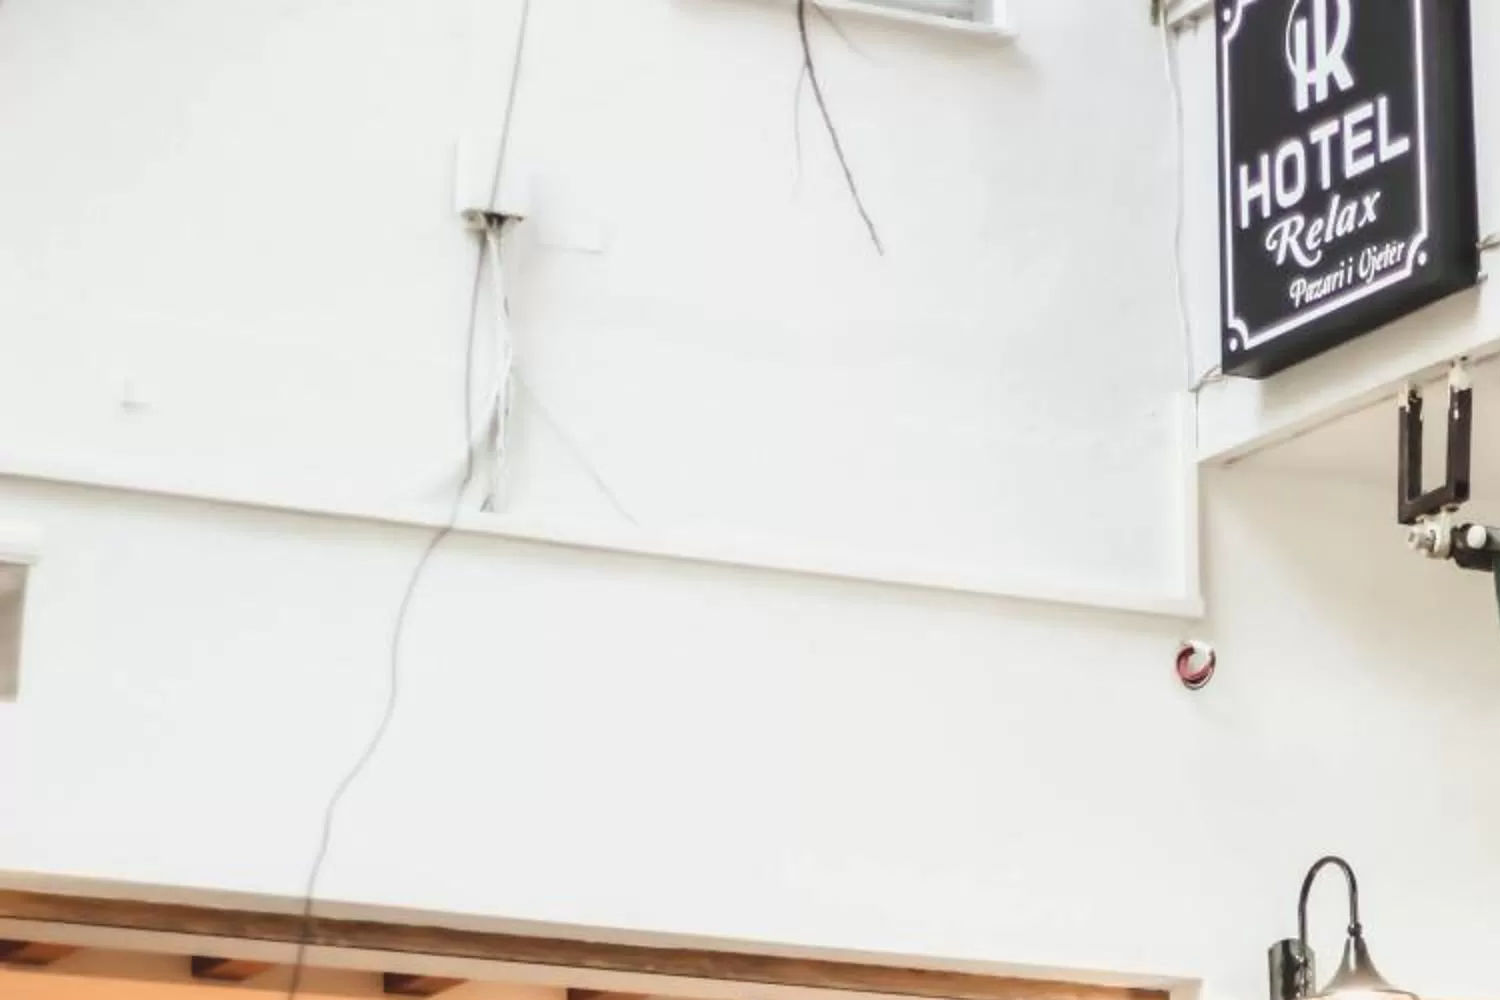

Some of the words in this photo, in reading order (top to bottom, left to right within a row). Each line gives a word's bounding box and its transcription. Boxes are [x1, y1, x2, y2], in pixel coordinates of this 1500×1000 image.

[1238, 94, 1411, 231] HOTEL
[1265, 190, 1381, 269] Relax
[1347, 256, 1353, 285] i
